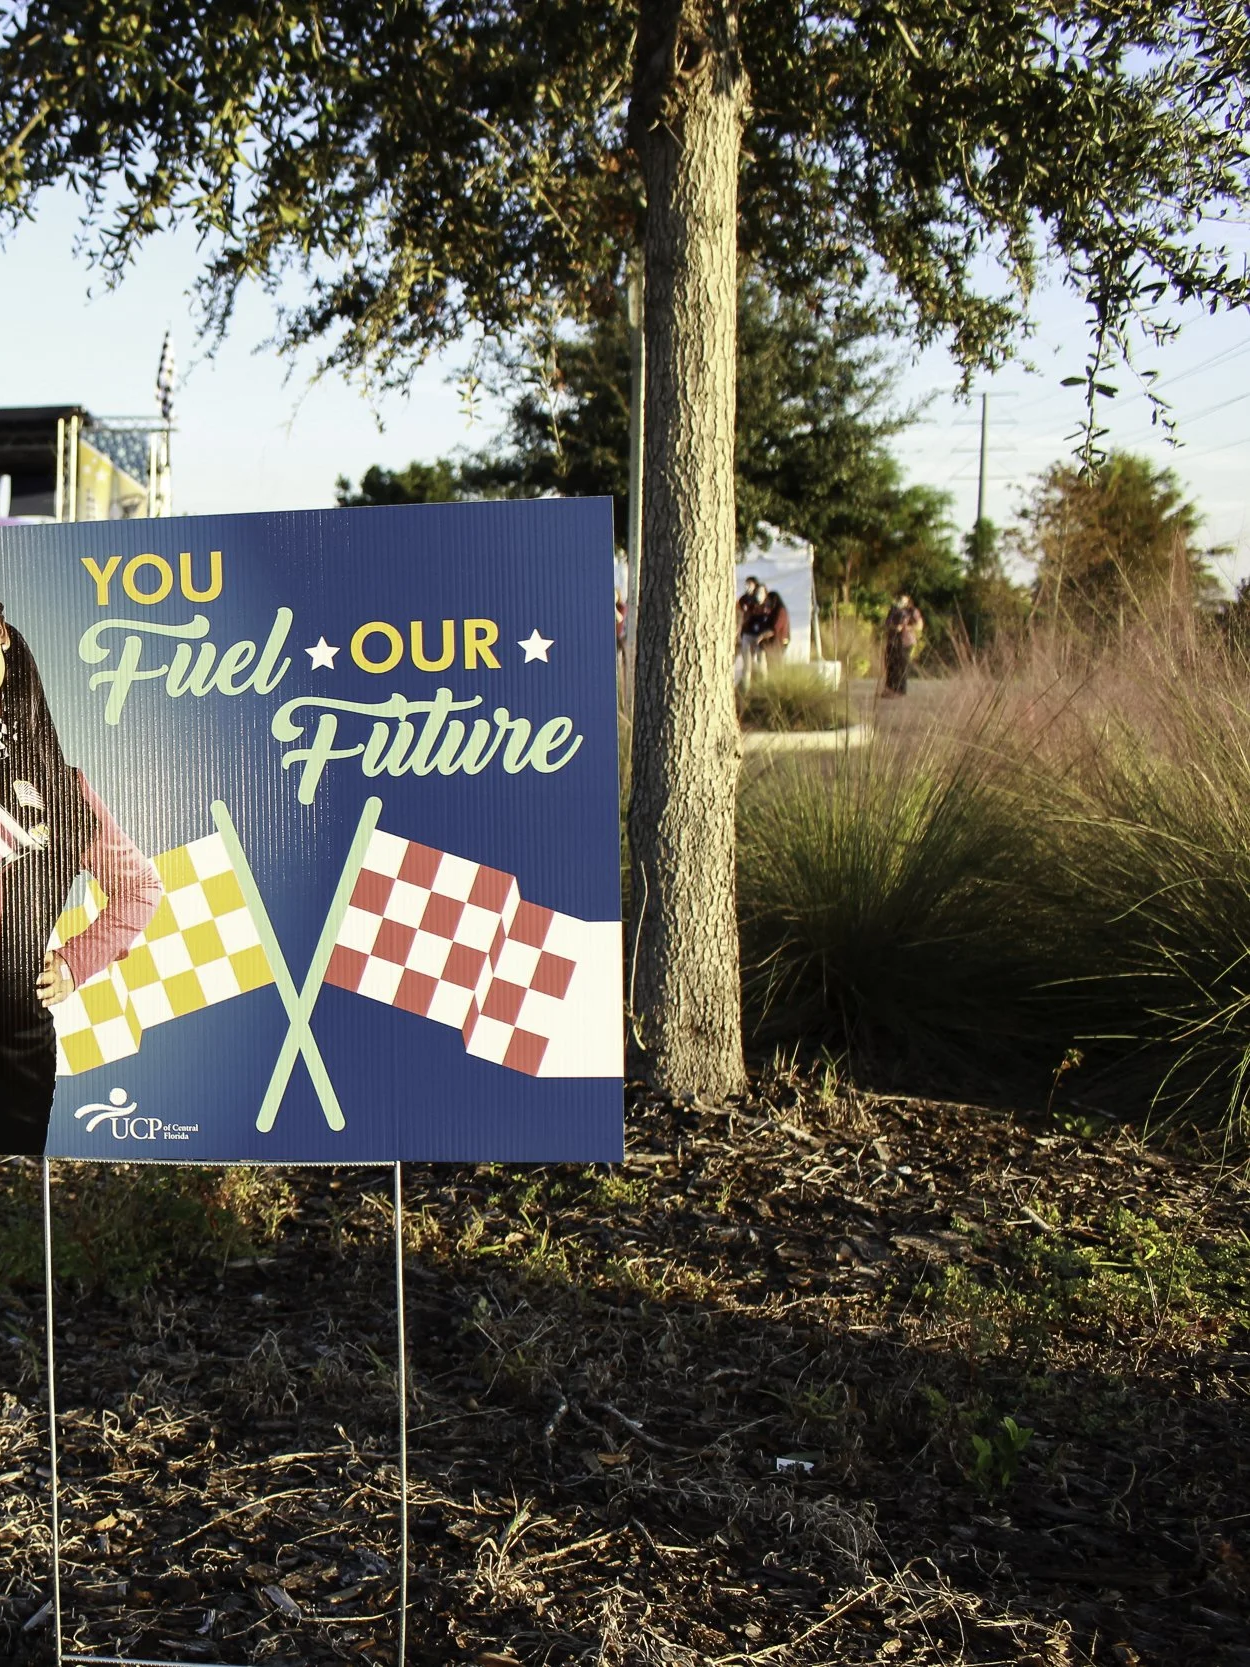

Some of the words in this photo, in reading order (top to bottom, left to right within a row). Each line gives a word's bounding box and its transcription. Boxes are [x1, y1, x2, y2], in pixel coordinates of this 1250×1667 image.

[81, 551, 224, 606] YOU
[78, 606, 294, 725] Fuel
[351, 618, 501, 674] OUR
[271, 687, 583, 805] Future
[110, 1117, 163, 1140] UCP
[163, 1124, 171, 1132] of
[172, 1124, 199, 1132] Central
[163, 1132, 189, 1140] Florida
